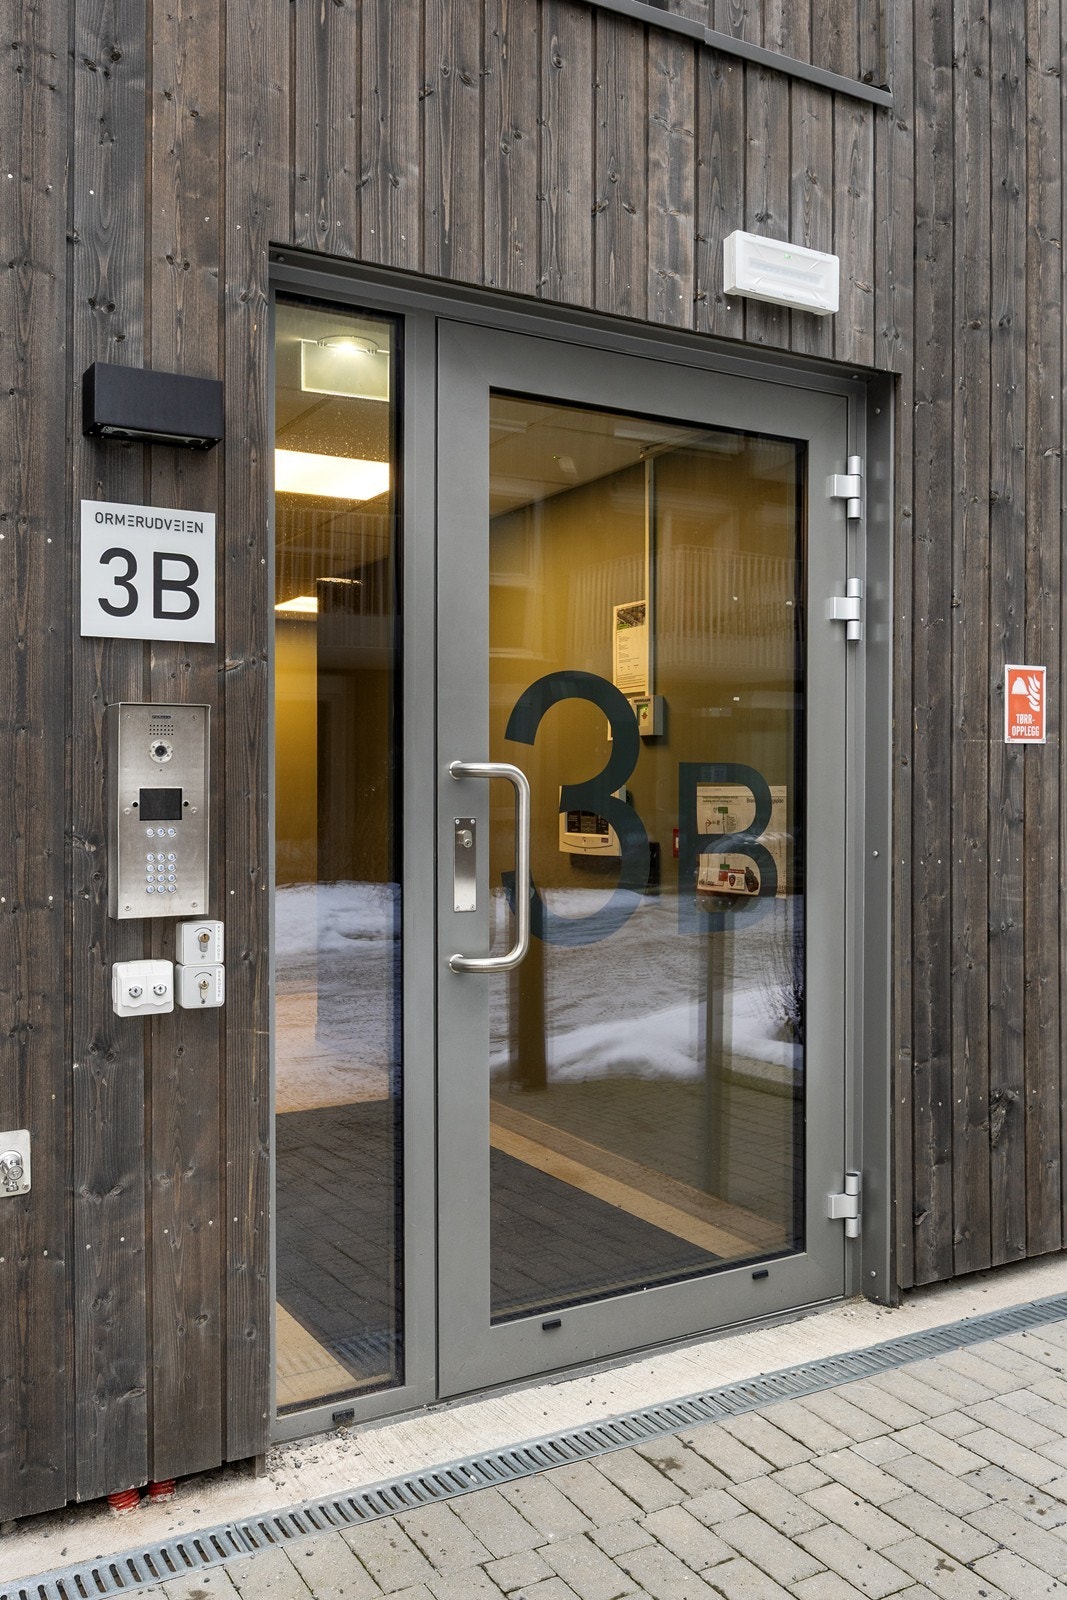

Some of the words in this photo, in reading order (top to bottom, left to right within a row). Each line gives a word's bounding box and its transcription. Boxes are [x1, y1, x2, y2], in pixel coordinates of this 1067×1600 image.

[94, 511, 204, 534] ORMERUDVEIEN
[97, 547, 200, 621] 3B
[1011, 725, 1040, 737] OPPLEGG
